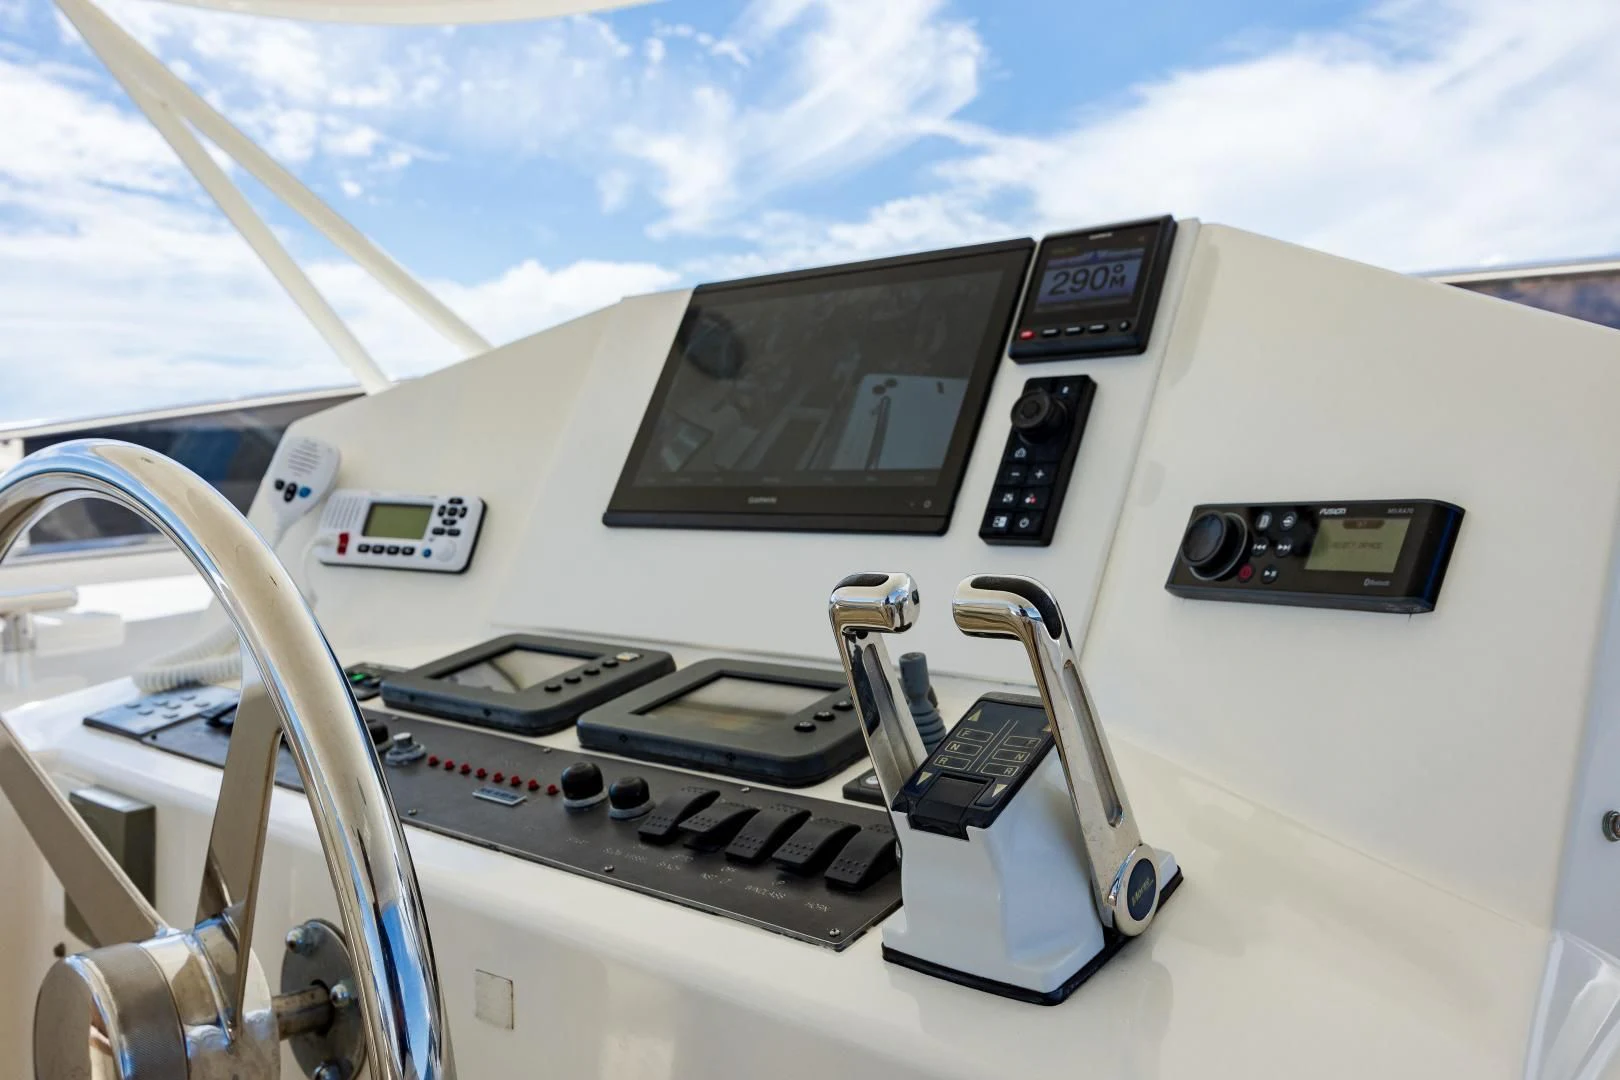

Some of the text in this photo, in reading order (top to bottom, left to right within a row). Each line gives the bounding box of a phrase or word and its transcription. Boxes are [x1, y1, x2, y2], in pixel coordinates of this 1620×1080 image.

[950, 743, 961, 751] N
[938, 757, 948, 765] R
[1014, 753, 1025, 761] N
[1003, 767, 1013, 775] R
